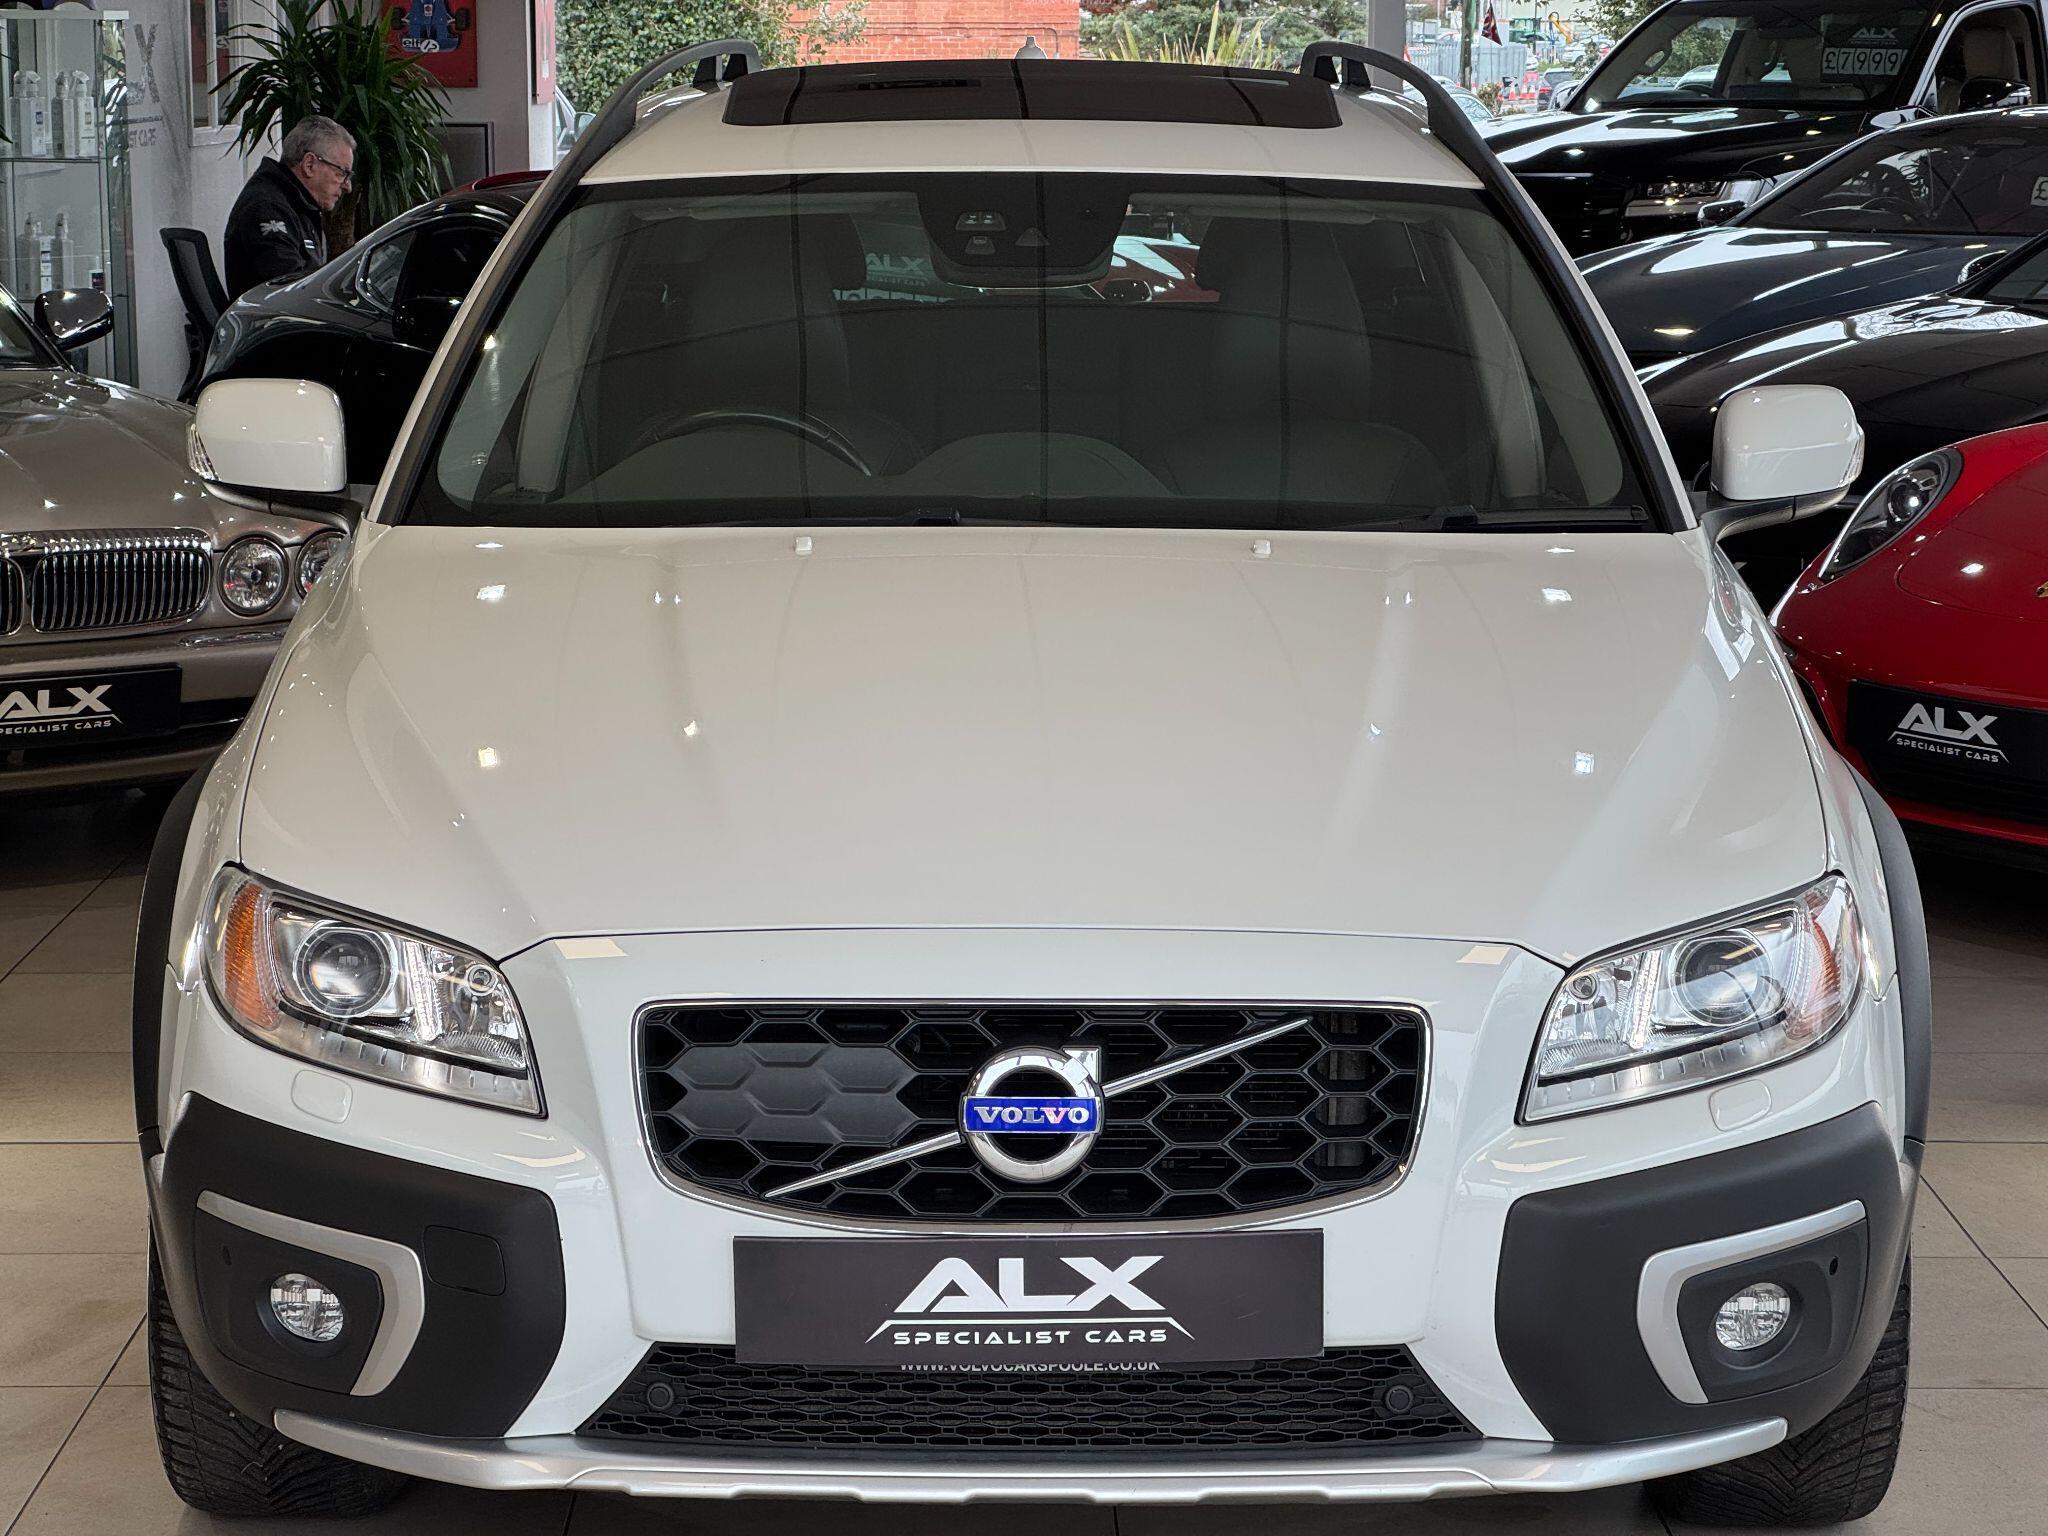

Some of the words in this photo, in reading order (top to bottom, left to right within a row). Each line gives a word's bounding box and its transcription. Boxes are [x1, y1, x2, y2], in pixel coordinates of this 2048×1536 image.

[1852, 27, 1898, 39] ALX
[1824, 51, 1899, 71] £7999
[866, 253, 924, 275] ALX
[0, 684, 112, 719] ALX
[0, 724, 68, 734] PECIALIST
[74, 720, 112, 730] CARS
[1898, 703, 1998, 745] ALX
[1896, 738, 1961, 756] SPECIALIST
[1965, 751, 1999, 763] CARS
[973, 1106, 1089, 1123] VOLVO
[893, 1256, 1166, 1313] ALX
[893, 1331, 1071, 1345] SPECIALIST
[1084, 1329, 1168, 1344] CARS
